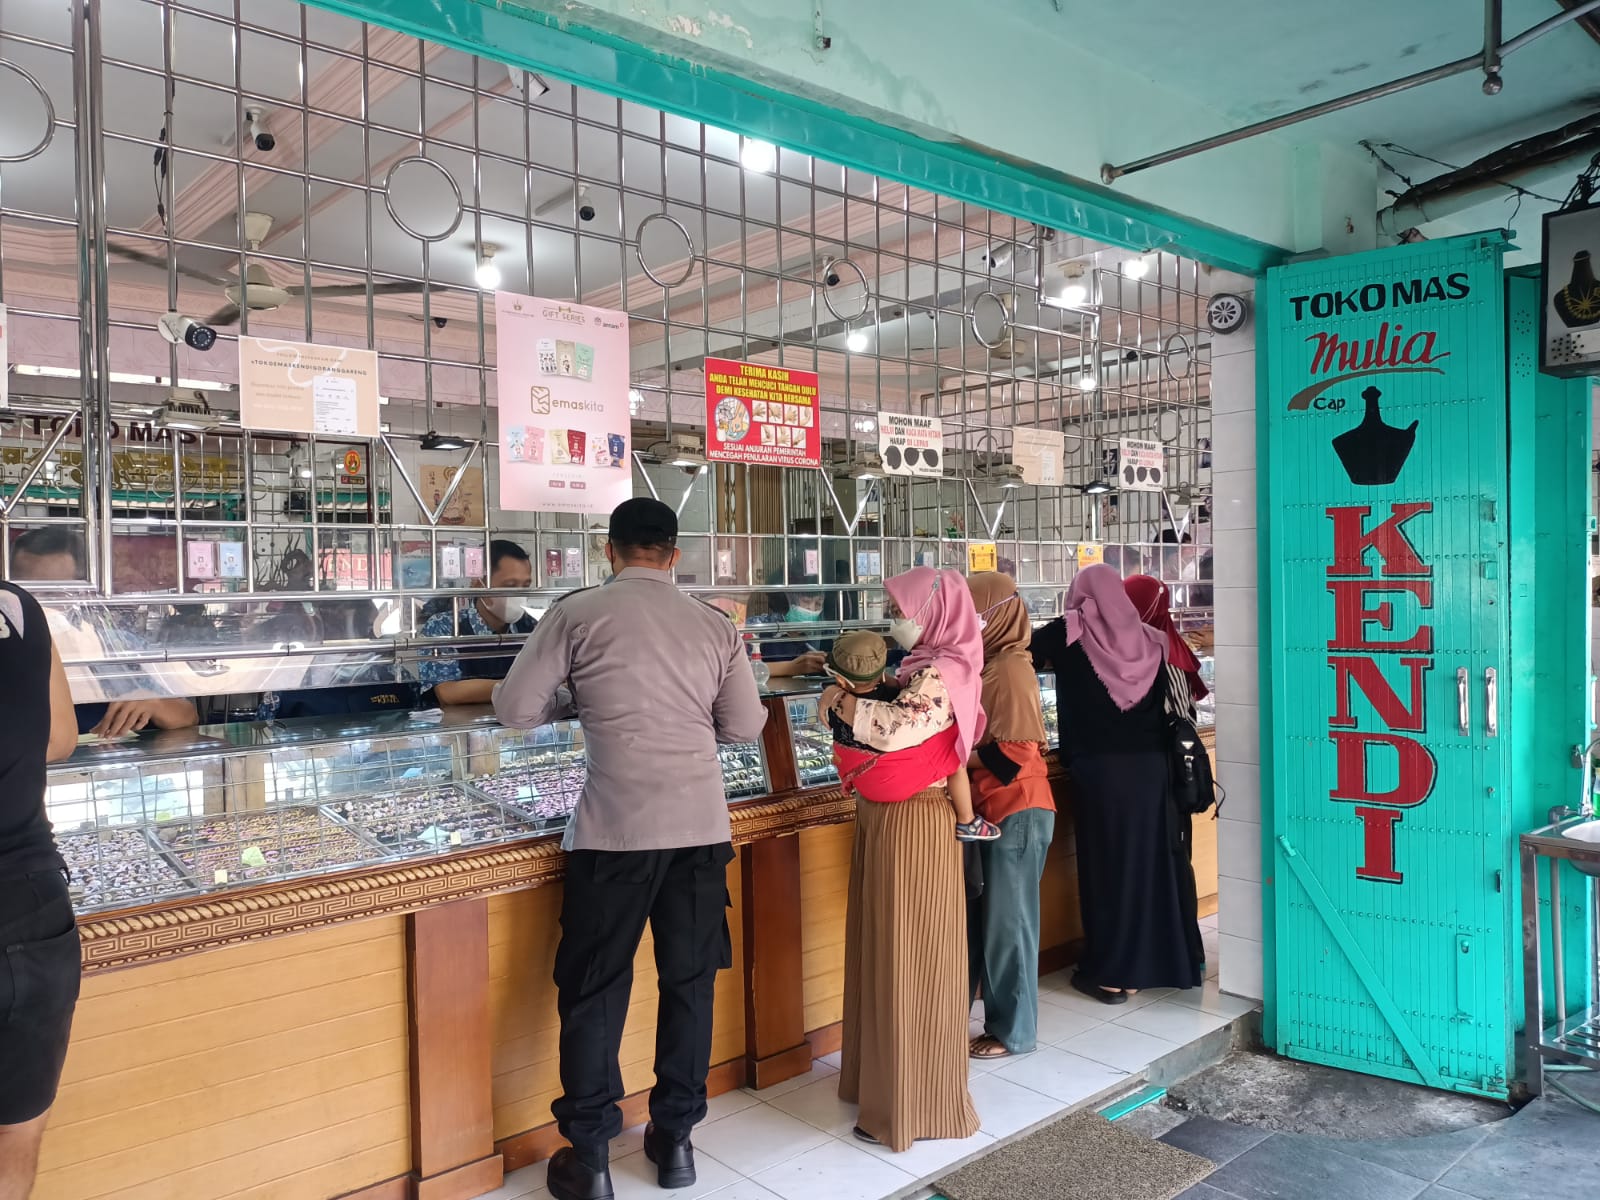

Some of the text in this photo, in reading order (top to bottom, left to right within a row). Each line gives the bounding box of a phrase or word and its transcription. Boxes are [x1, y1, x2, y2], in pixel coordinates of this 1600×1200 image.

[1289, 272, 1470, 321] TOKO MAS
[541, 309, 559, 318] GIFT
[562, 312, 586, 323] SERIES
[740, 365, 789, 381] TERIMA KASIH
[709, 373, 817, 396] ANDA TELAH MENCUCI TANGAN DULU
[716, 384, 812, 406] DEMI KESEHATAN KITA BERSAMA
[551, 399, 604, 413] emaskita
[1313, 397, 1346, 413] Cap
[889, 416, 932, 428] MOHON MAAF
[894, 426, 905, 436] DAN
[723, 442, 806, 457] SESUAI ANJURAN PEMERINTAH
[890, 437, 906, 446] HARAP
[709, 450, 819, 466] MENCEGAH PENULARAN VIRUS CORONA
[1325, 501, 1438, 884] KENDI
